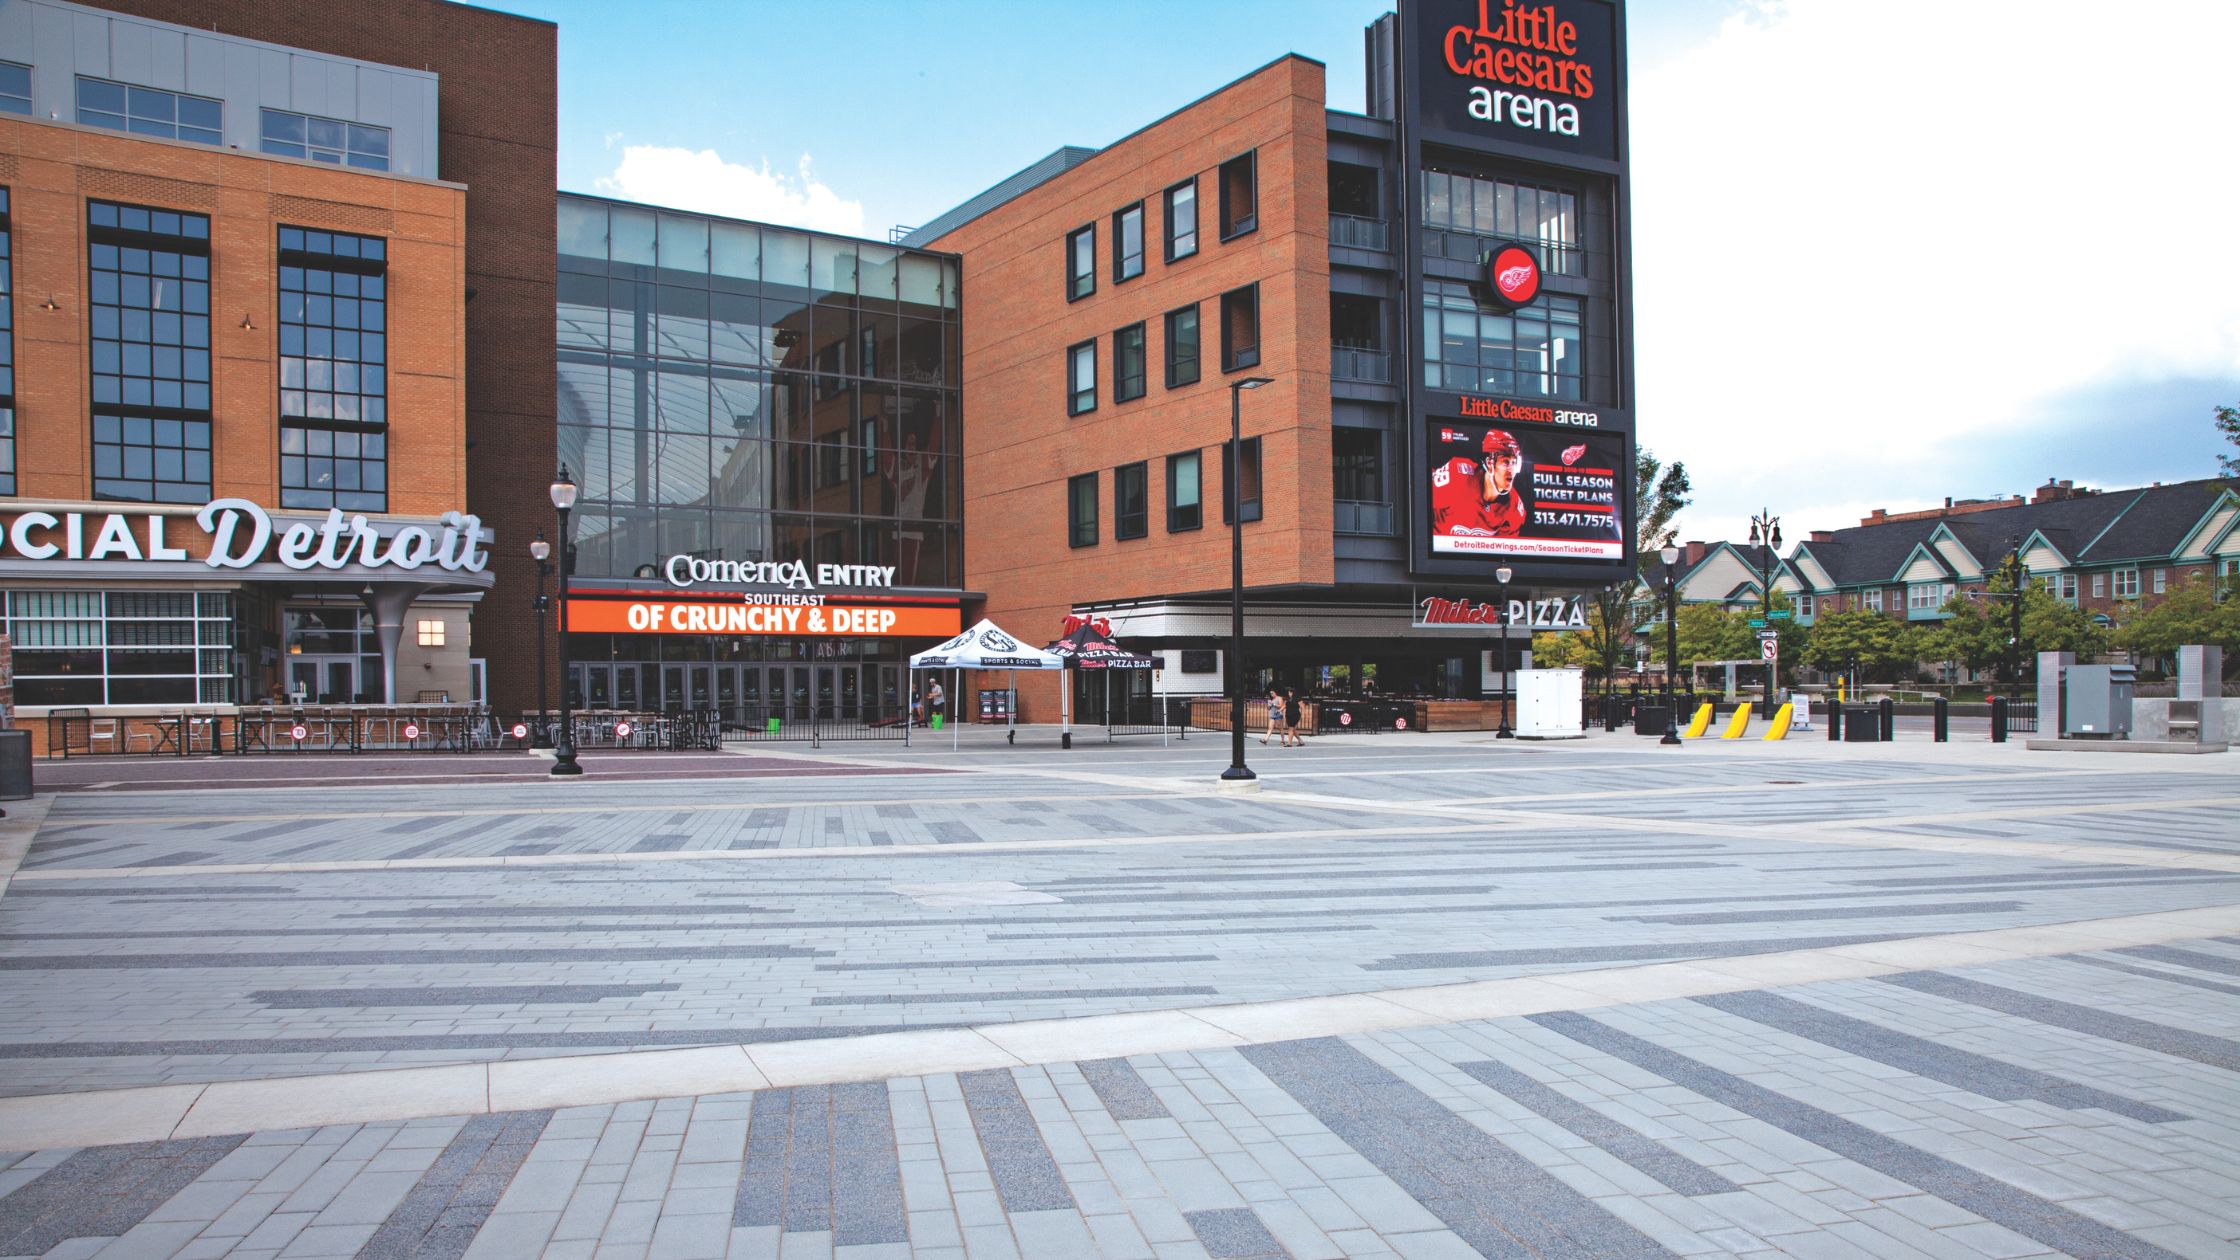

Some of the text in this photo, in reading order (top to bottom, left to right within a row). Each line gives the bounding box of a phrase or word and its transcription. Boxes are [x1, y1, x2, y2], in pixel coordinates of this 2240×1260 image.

[1475, 0, 1577, 56] Little
[1444, 25, 1594, 99] Caesars
[1468, 86, 1579, 136] arena
[1461, 396, 1598, 427] Little Caesars arena
[1441, 431, 1452, 440] 59
[1533, 473, 1613, 489] FULL SEASON
[1533, 488, 1613, 503] TICKET PLANS
[1534, 511, 1614, 528] 313.471.7575
[0, 498, 489, 573] CIAL Detroit
[1454, 540, 1604, 554] DetroitRedWings.com/SeasonTicketPlans
[817, 563, 896, 587] ENTRY
[744, 593, 826, 607] SOUTHEAST
[627, 603, 896, 633] OF CRUNCHY & DEEP
[1420, 597, 1585, 626] Mike's PIZZA
[1077, 650, 1110, 658] PIZZA
[1107, 660, 1133, 668] PIZZA
[1134, 660, 1151, 668] BAR
